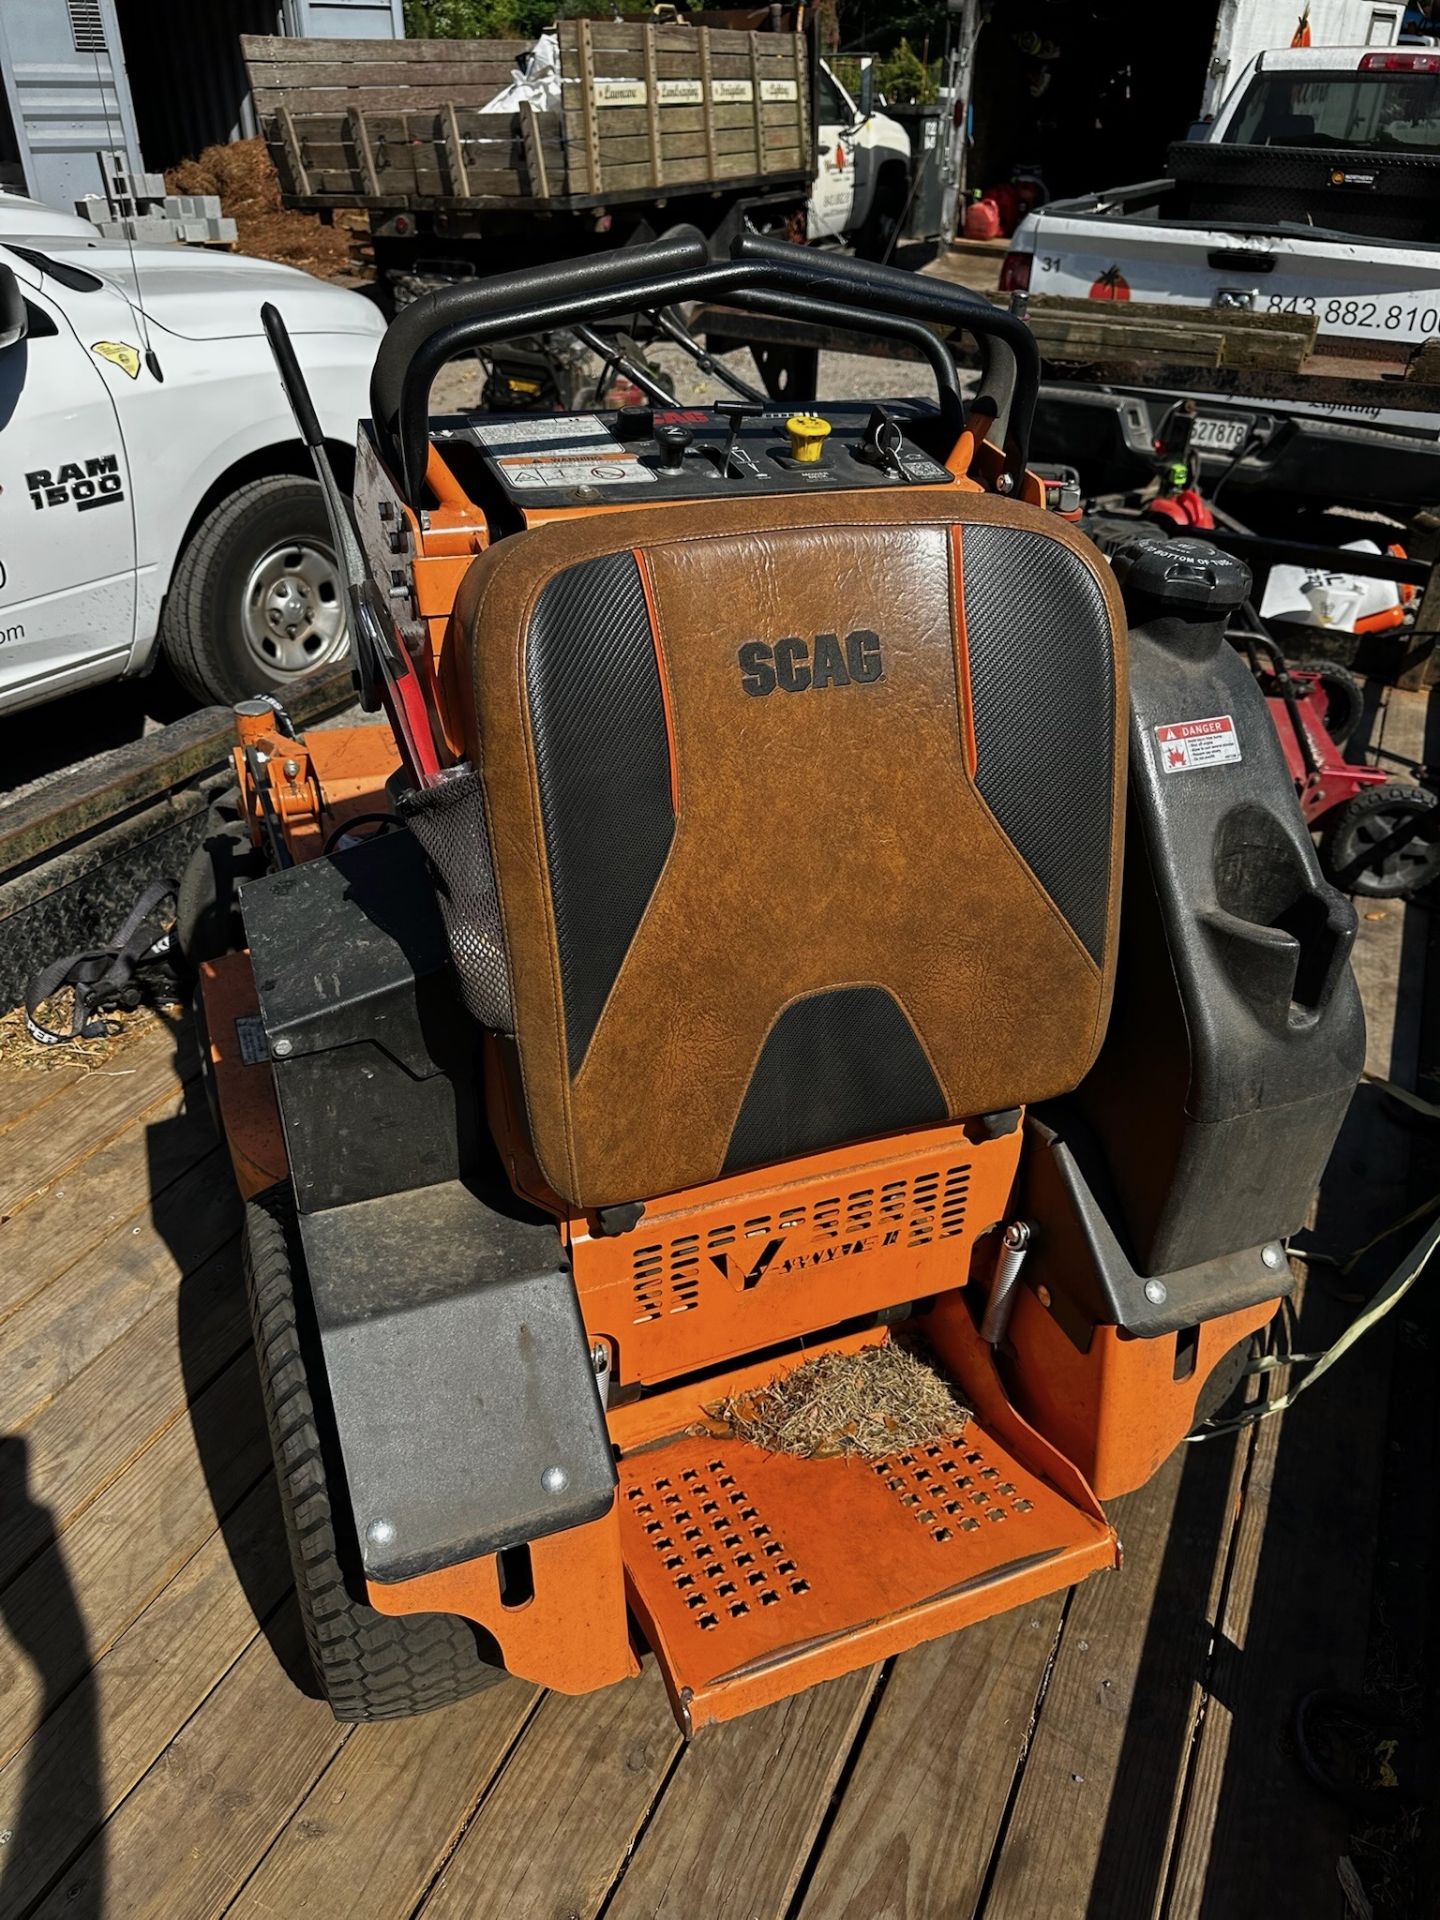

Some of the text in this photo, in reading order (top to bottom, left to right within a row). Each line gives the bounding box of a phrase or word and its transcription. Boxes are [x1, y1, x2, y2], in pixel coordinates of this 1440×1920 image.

[1041, 257, 1061, 273] 31
[24, 453, 120, 491] RAM
[29, 473, 122, 511] 1500
[1153, 550, 1195, 564] BOTTOM
[737, 629, 883, 698] SCAG
[1181, 721, 1222, 737] DANGER
